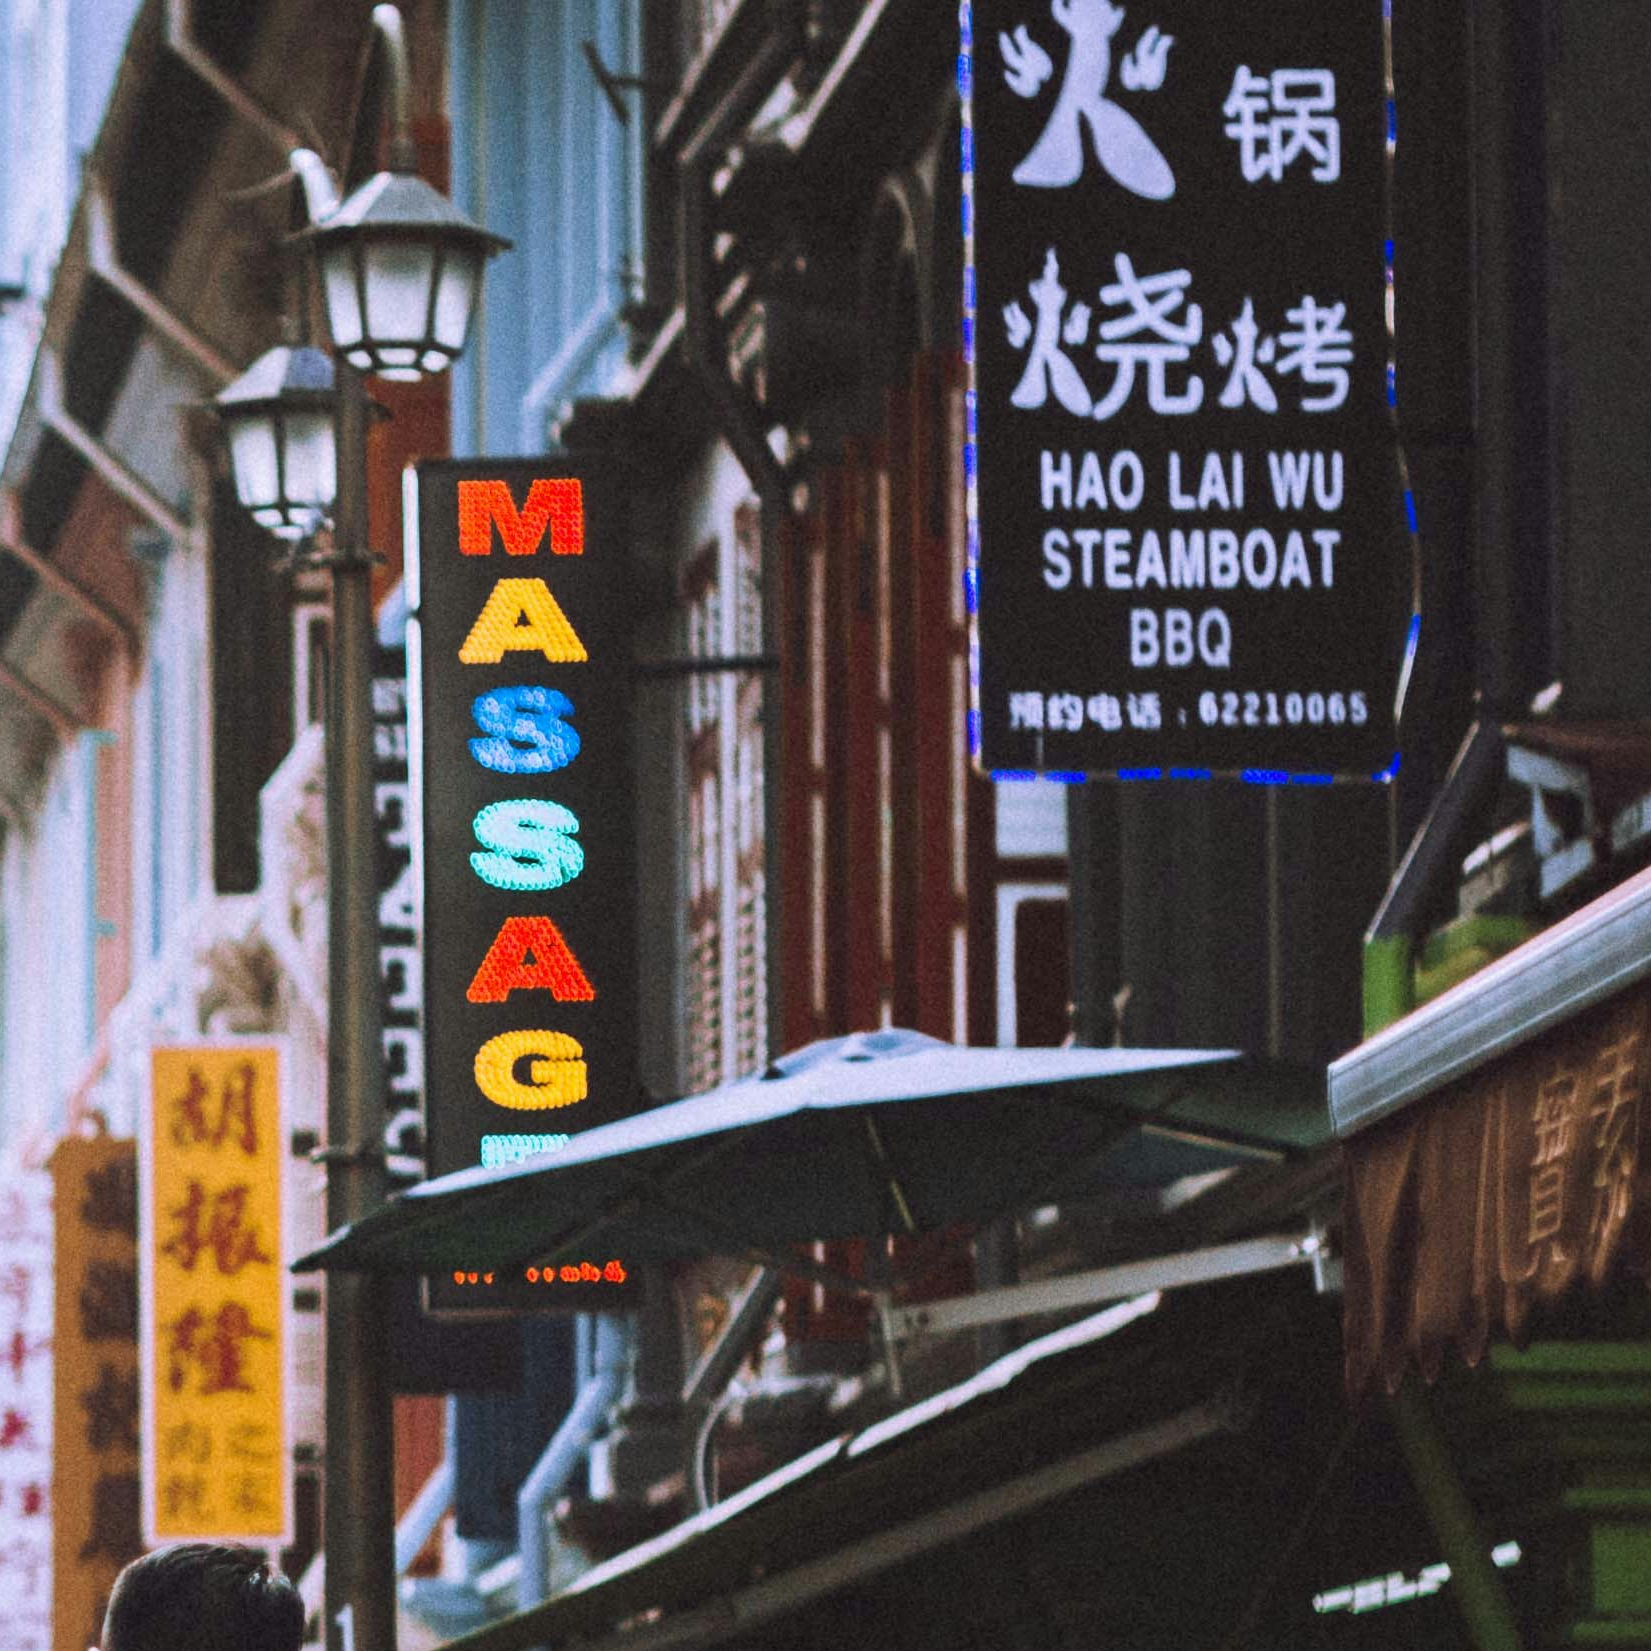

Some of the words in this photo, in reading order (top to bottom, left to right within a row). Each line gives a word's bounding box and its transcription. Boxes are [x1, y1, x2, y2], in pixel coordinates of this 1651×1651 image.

[1040, 450, 1144, 511] HAO
[1168, 450, 1245, 509] LAI
[1268, 450, 1344, 510] WU
[1041, 528, 1342, 591] STEAMBOAT
[1129, 607, 1233, 668] BBQ
[456, 478, 596, 1170] MASSAG
